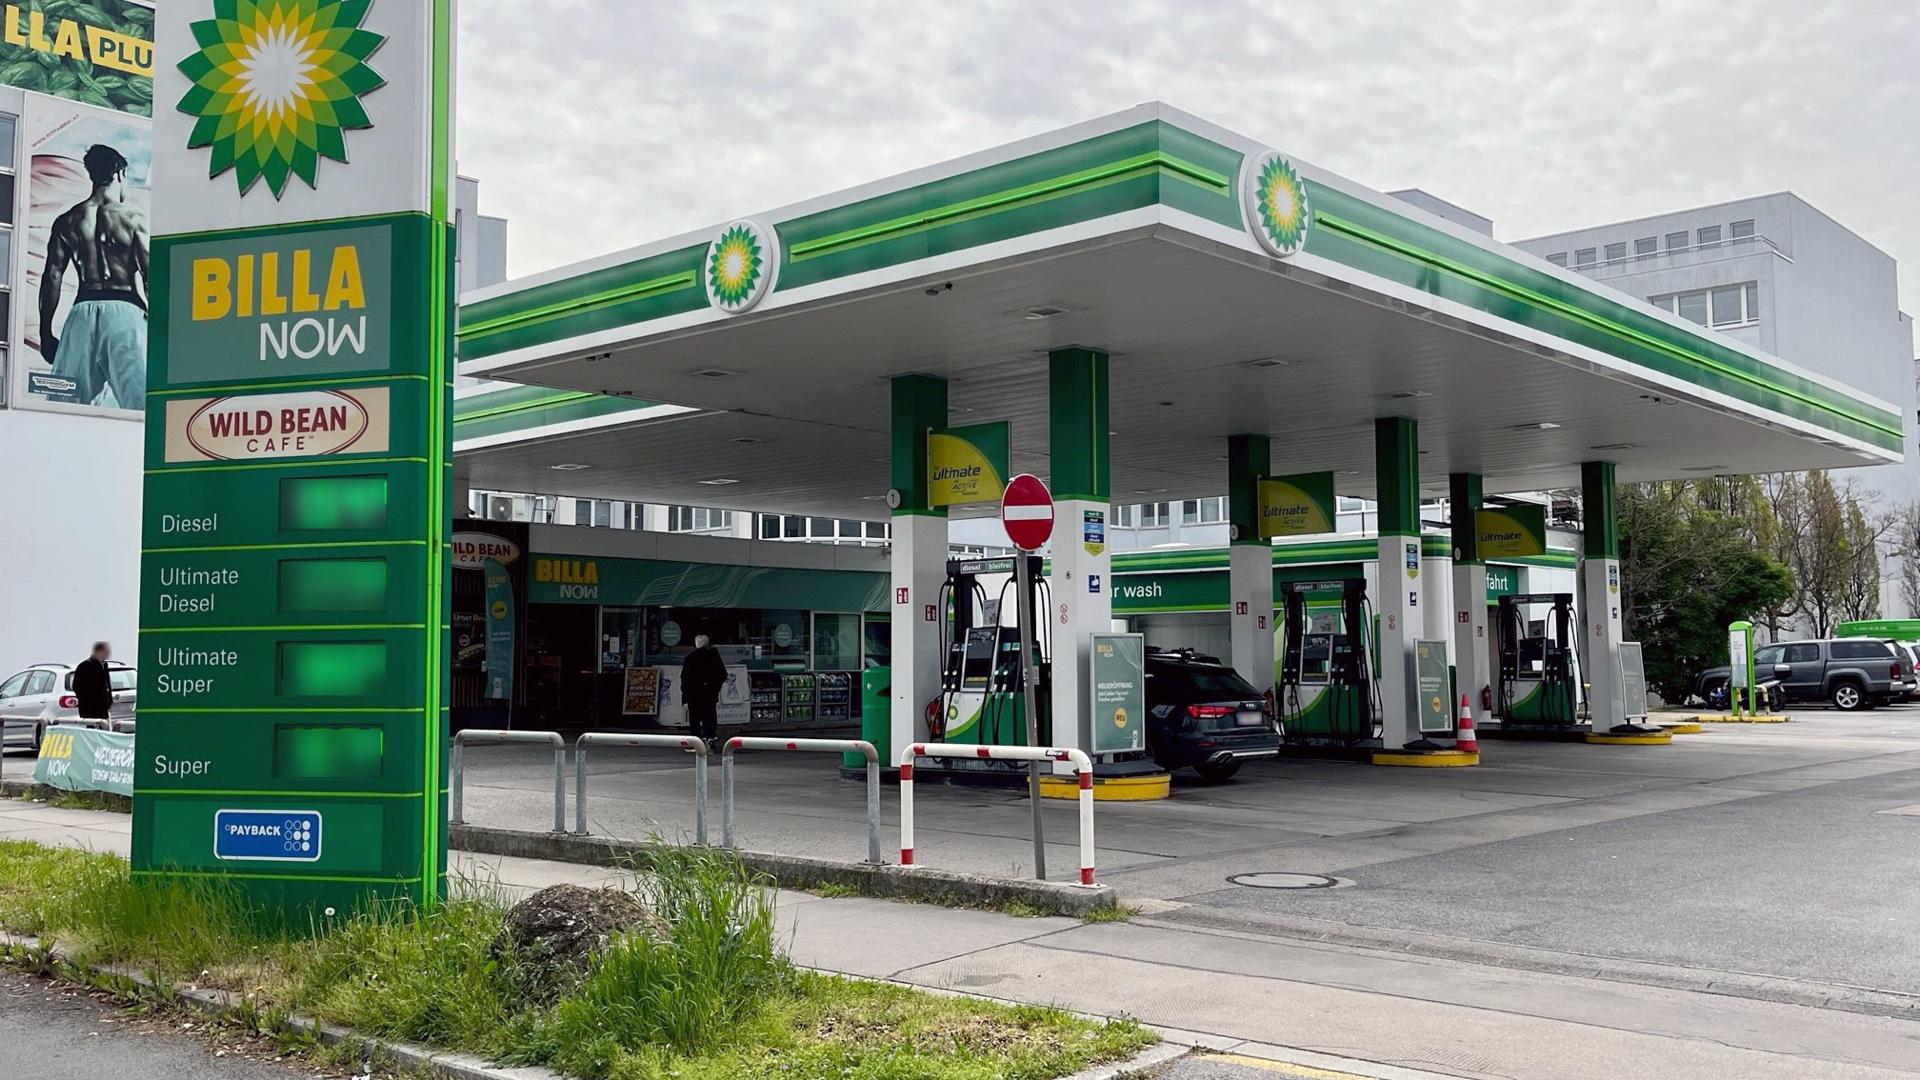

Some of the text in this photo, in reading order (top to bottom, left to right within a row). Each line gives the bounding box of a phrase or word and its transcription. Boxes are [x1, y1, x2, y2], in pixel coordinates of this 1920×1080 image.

[192, 245, 366, 321] BILLA
[260, 316, 366, 361] NOW
[209, 405, 347, 438] WILD BEAN
[246, 436, 305, 453] CAFE
[933, 464, 981, 480] ultimate
[162, 512, 218, 533] Diesel
[451, 543, 511, 557] ILD BEAN
[535, 559, 599, 584] BILLA
[962, 561, 1012, 571] diesel bleifrei
[160, 567, 239, 586] Ultimate
[1485, 572, 1509, 591] fahrt
[560, 585, 598, 599] NOW
[1123, 581, 1162, 598] wash
[159, 593, 215, 613] Diesel
[158, 647, 238, 666] Ultimate
[157, 674, 214, 697] Super
[47, 759, 71, 777] NOW
[154, 754, 212, 779] Super
